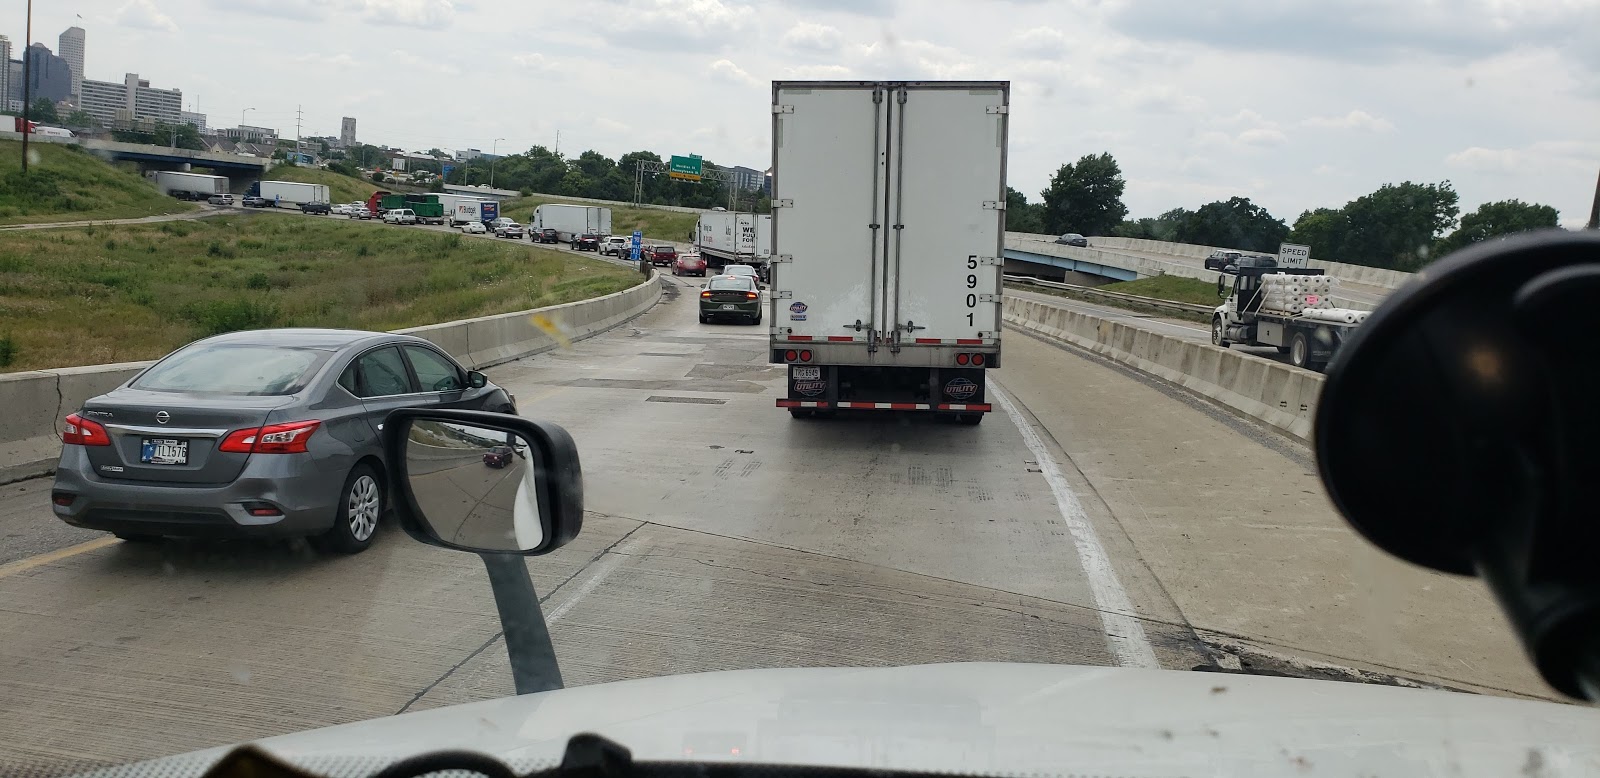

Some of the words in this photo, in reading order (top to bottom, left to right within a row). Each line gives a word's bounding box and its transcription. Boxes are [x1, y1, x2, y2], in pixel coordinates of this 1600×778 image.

[464, 206, 476, 216] Budget
[1282, 248, 1307, 256] SPEED
[796, 382, 825, 390] UTILITY
